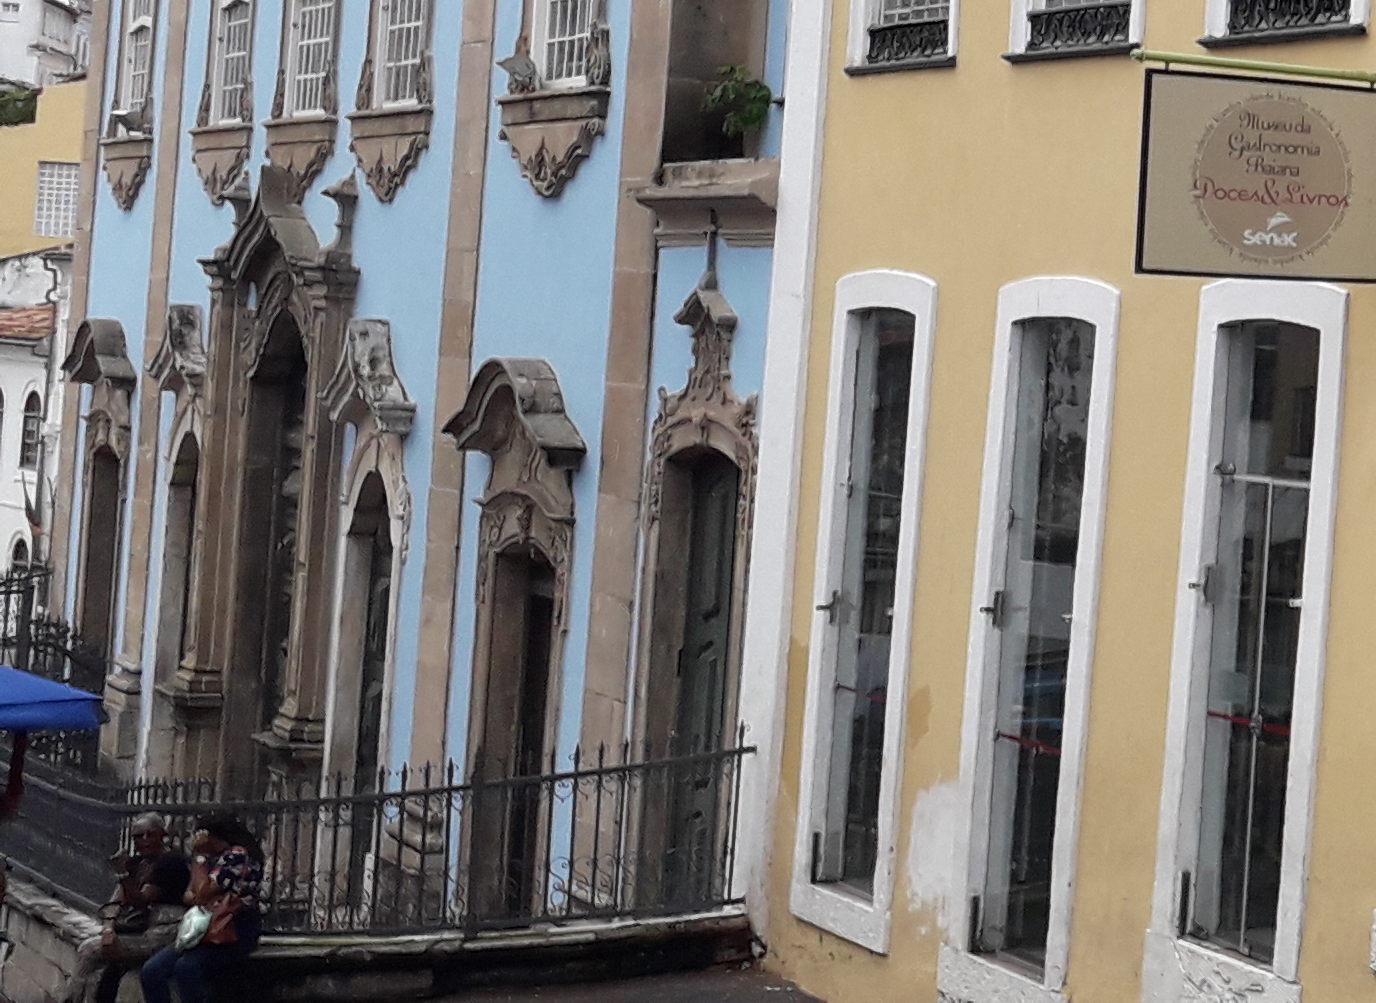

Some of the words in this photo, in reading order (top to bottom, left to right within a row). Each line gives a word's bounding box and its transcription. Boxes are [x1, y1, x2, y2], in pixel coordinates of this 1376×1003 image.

[1239, 110, 1294, 133] Museu
[1295, 115, 1312, 134] da
[1228, 131, 1321, 160] Gastronomia
